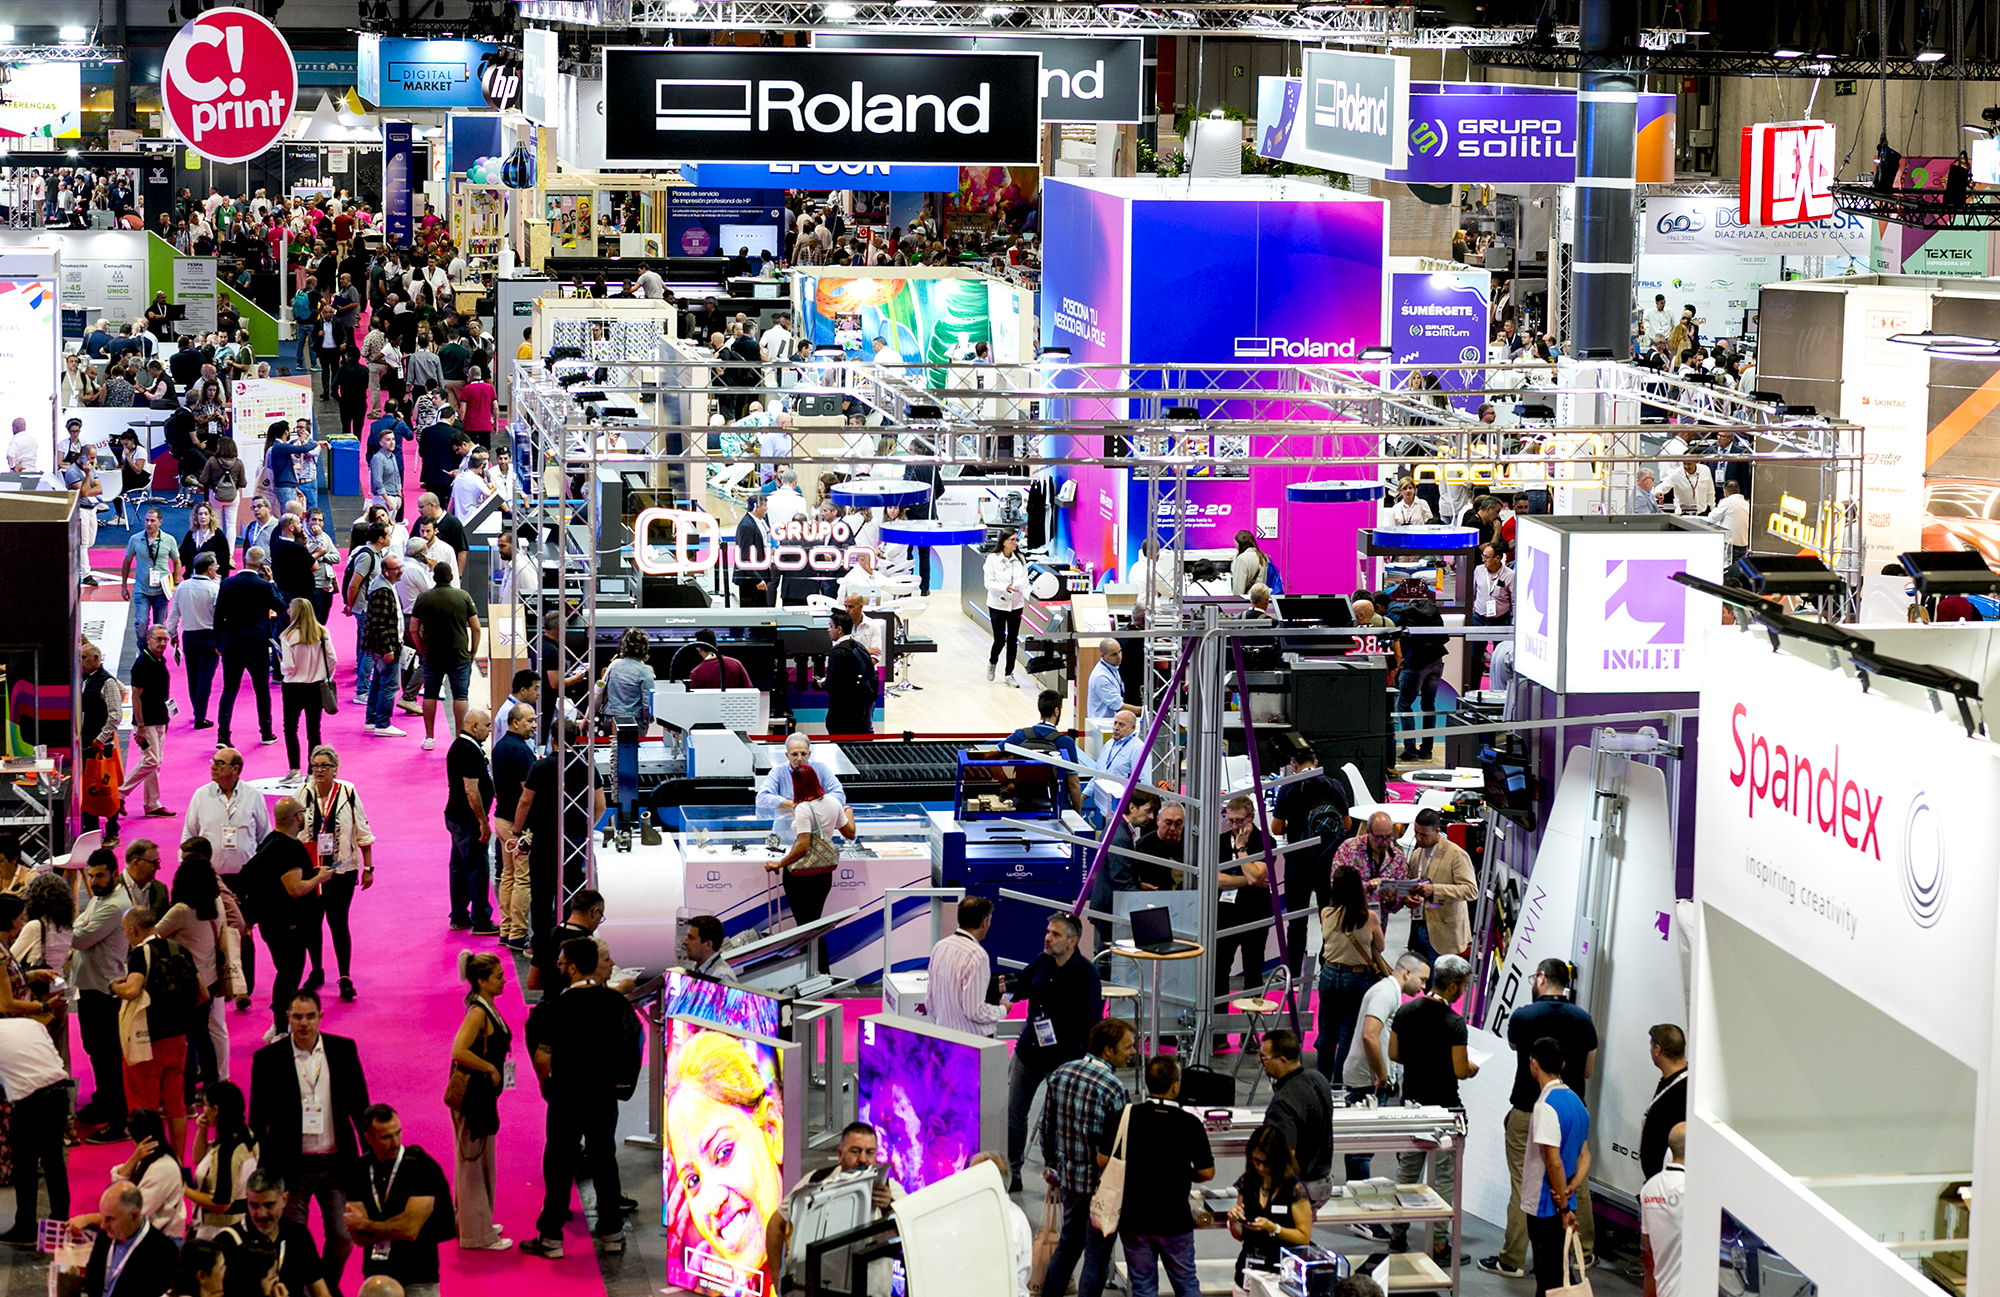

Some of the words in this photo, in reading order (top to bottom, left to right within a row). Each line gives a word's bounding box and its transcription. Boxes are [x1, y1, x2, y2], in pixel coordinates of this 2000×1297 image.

[166, 24, 246, 102] C!
[403, 70, 452, 79] DIGITAL
[403, 82, 452, 91] MARKET
[491, 65, 519, 111] hp
[192, 90, 286, 142] print
[758, 80, 990, 134] Roland
[1335, 77, 1388, 137] Roland
[1458, 119, 1562, 134] GRUPO
[706, 198, 735, 206] profesional
[1714, 229, 1768, 239] DÍAZ-PLAZA,
[1771, 230, 1820, 239] CANDELAS
[1820, 231, 1827, 239] Y
[1849, 230, 1867, 239] S.A.
[1925, 248, 1972, 259] TEXTEK
[107, 286, 129, 294] ÚNICO
[1401, 303, 1473, 316] SUMÉRGETE
[1425, 329, 1470, 337] solitium
[1270, 337, 1355, 358] Roland
[1874, 399, 1907, 408] SKINTAC
[1868, 512, 1890, 528] SHAG
[770, 521, 850, 542] GRUPO
[734, 544, 877, 571] woon
[1603, 648, 1685, 670] INGLET
[1729, 702, 1884, 862] Spandex
[1745, 846, 1796, 905] inspiring
[1800, 886, 1858, 940] creativity
[1515, 884, 1547, 961] TWIN
